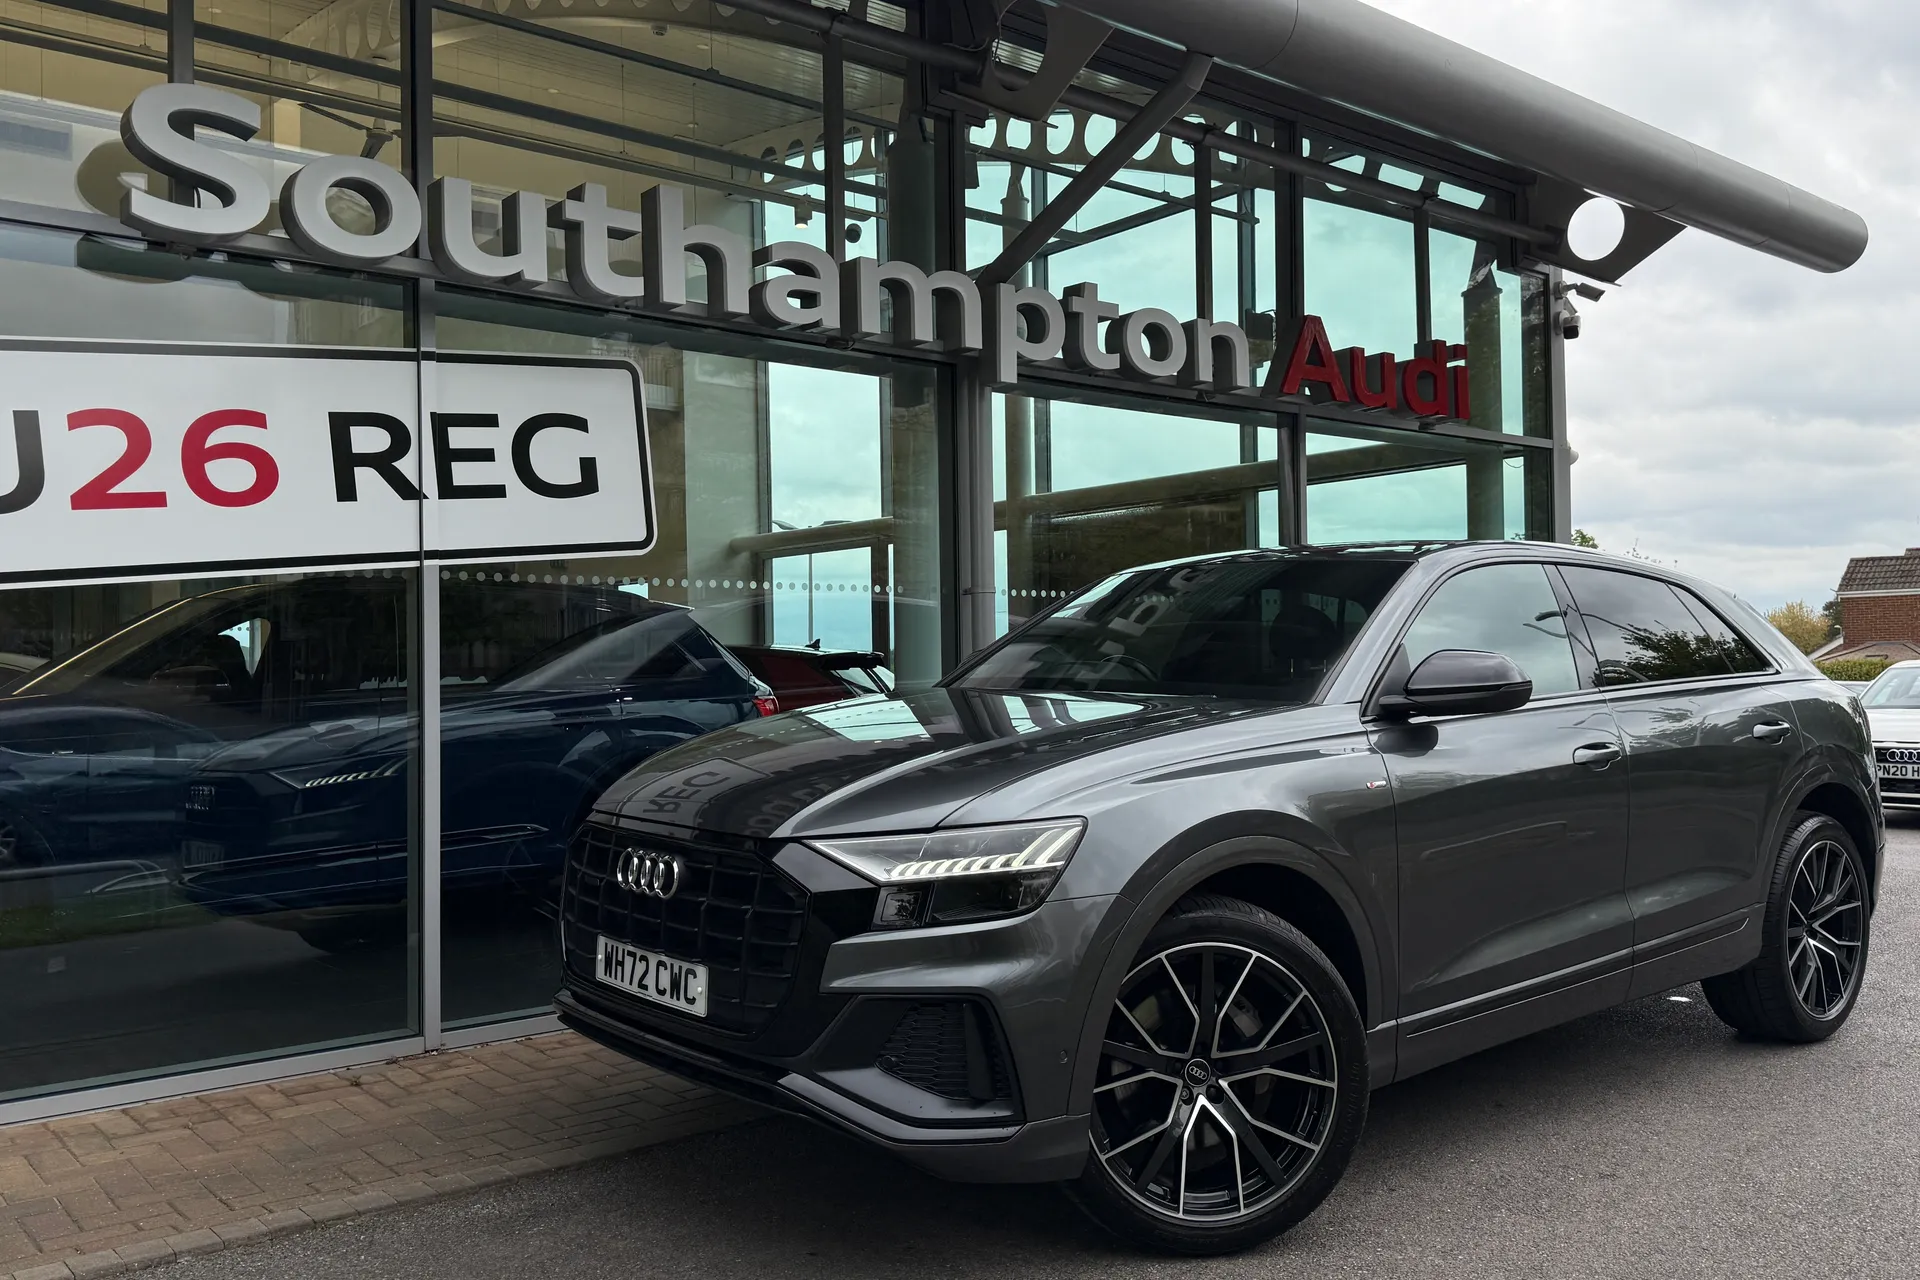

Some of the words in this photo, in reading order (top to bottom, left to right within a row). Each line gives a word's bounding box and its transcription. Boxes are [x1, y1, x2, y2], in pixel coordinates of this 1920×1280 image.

[120, 83, 1251, 385] Southampton
[1277, 314, 1470, 420] Audi
[327, 410, 600, 502] REG
[603, 941, 650, 992] WH72
[654, 959, 698, 1006] CWC
